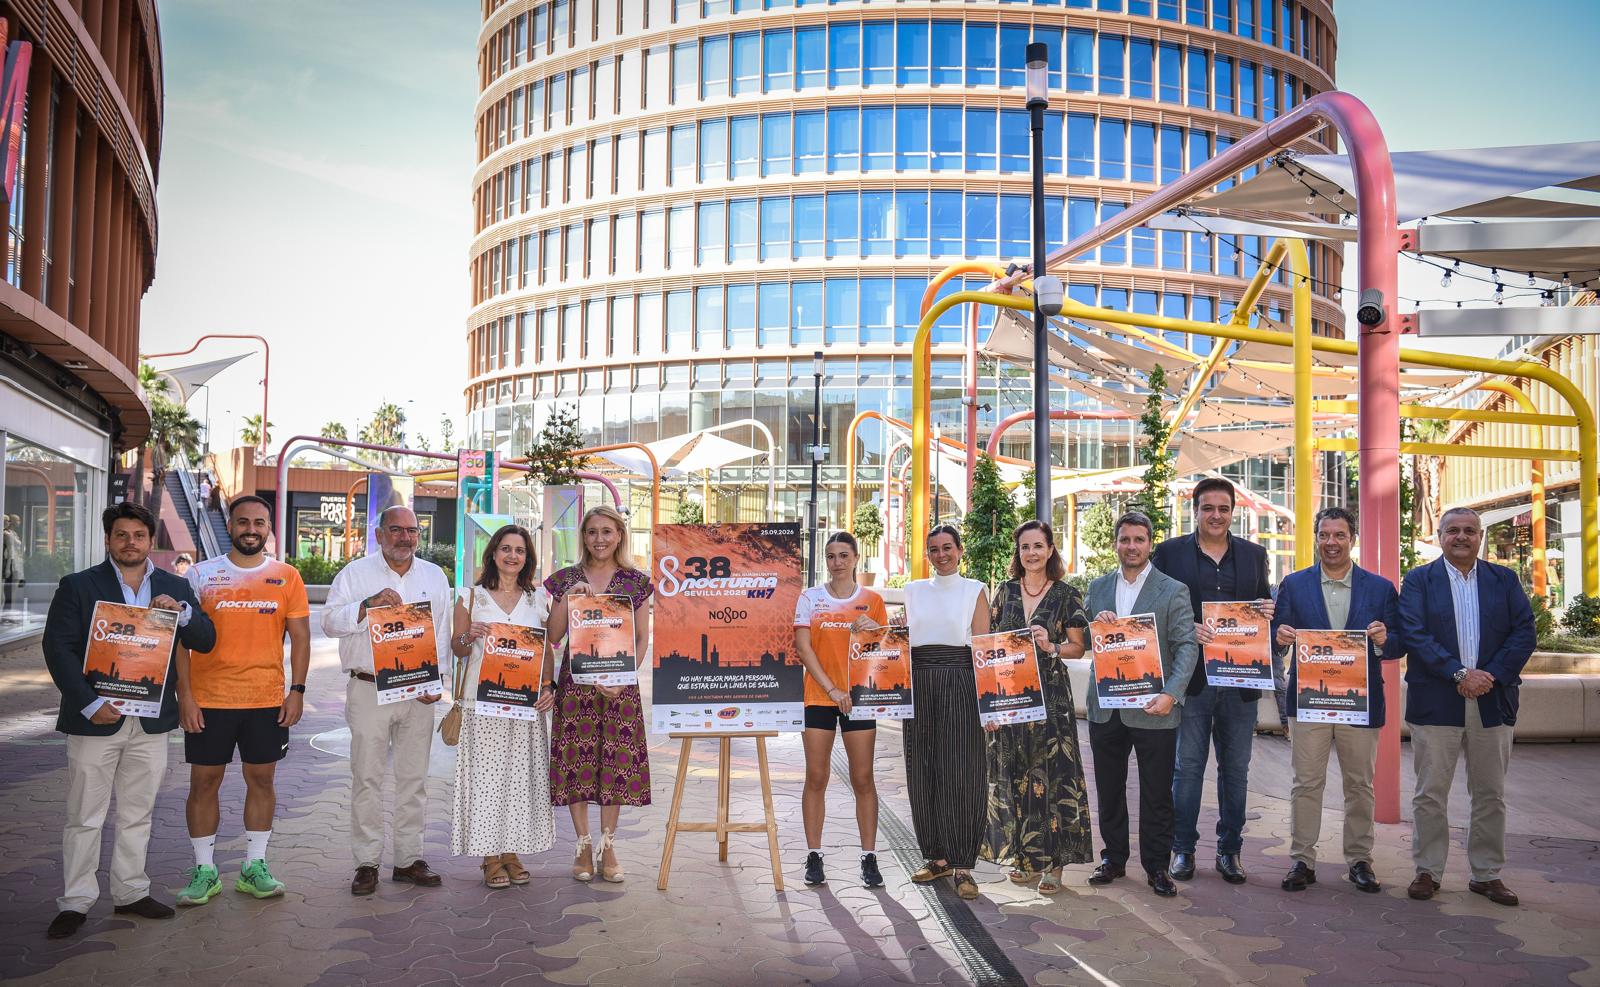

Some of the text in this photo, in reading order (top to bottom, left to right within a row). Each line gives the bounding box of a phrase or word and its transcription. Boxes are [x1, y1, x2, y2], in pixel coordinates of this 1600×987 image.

[685, 556, 731, 579] 38
[679, 577, 778, 592] NOCTURNA
[215, 600, 278, 610] NOCTURNA
[582, 609, 602, 620] 38
[383, 621, 405, 634] 38
[1216, 617, 1238, 628] 38
[109, 622, 136, 636] 38
[497, 638, 517, 649] 38
[1105, 633, 1126, 645] 38
[862, 642, 880, 652] 38
[1312, 645, 1333, 655] 38
[986, 648, 1006, 660] 38
[691, 682, 709, 690] ESTAR
[758, 681, 779, 689] SALIDA
